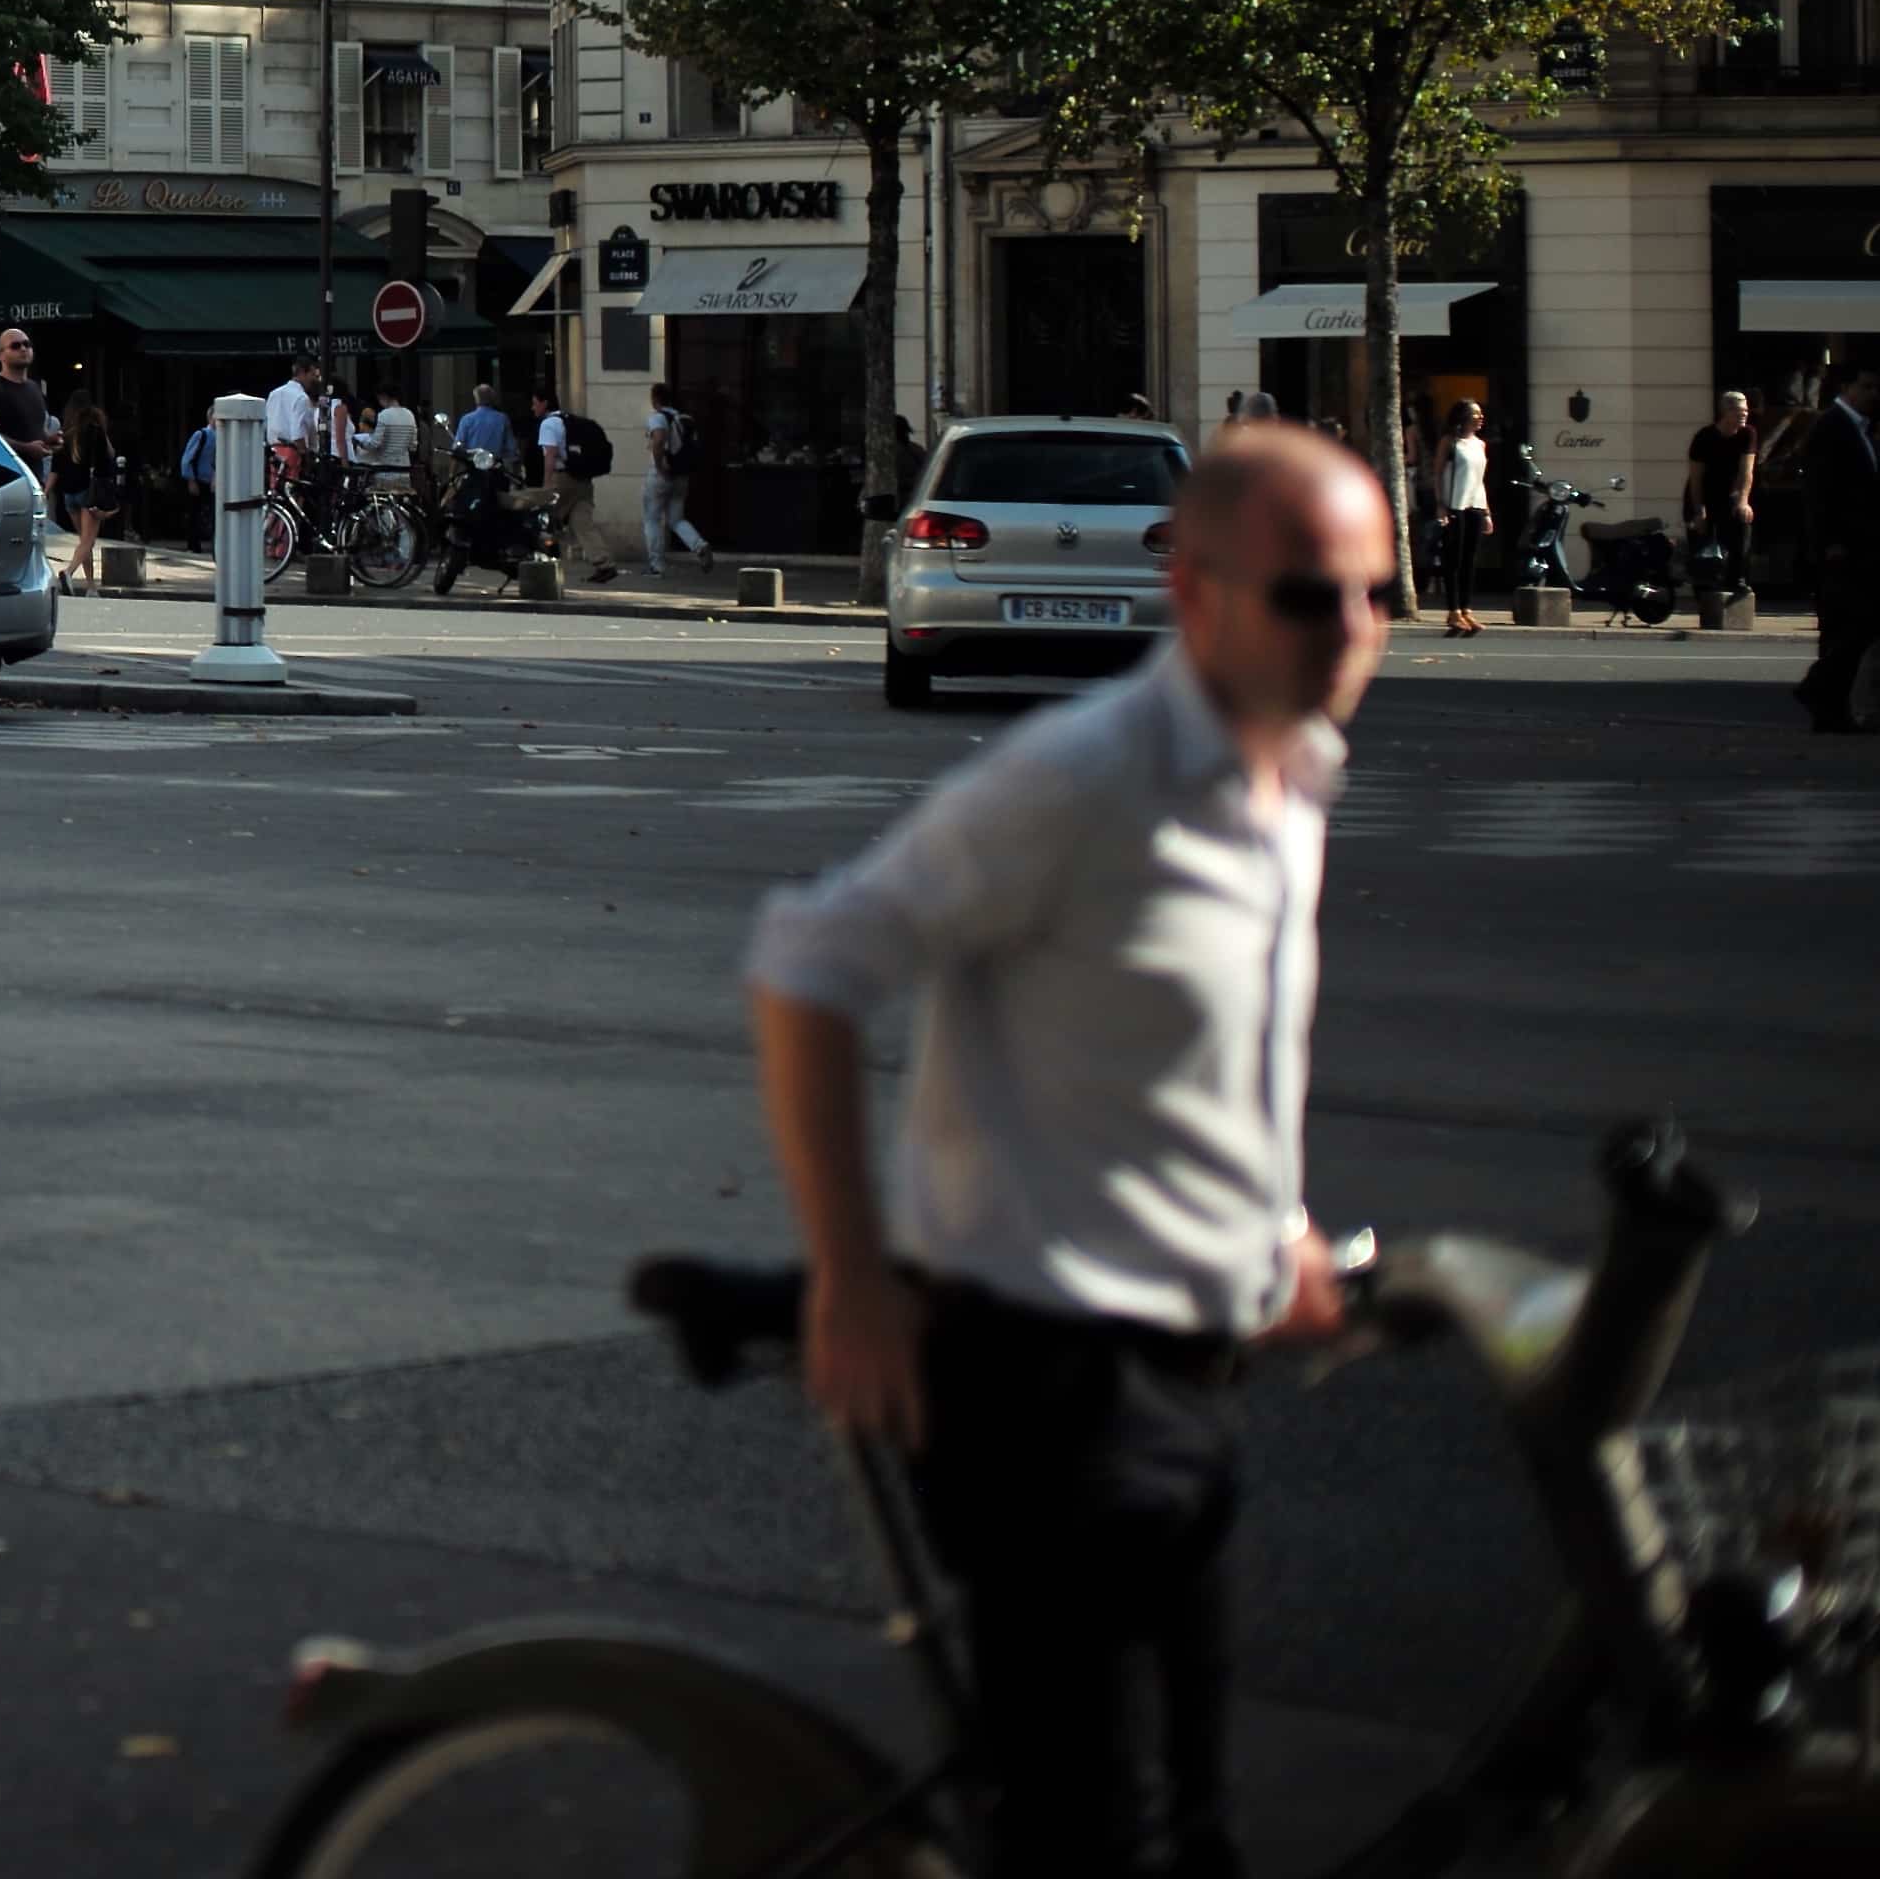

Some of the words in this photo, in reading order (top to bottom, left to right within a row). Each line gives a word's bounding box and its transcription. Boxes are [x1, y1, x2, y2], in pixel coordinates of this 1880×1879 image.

[388, 70, 438, 86] AGATHA
[92, 178, 131, 209] Le
[650, 181, 840, 222] SWAROVSKI
[1346, 226, 1429, 256] Caier
[611, 249, 635, 258] PLACE
[694, 292, 798, 309] SWAROVSKI
[10, 302, 64, 321] QUEBEC
[1305, 307, 1367, 330] Cartie
[277, 336, 297, 354] LE
[1554, 429, 1607, 448] Cartier
